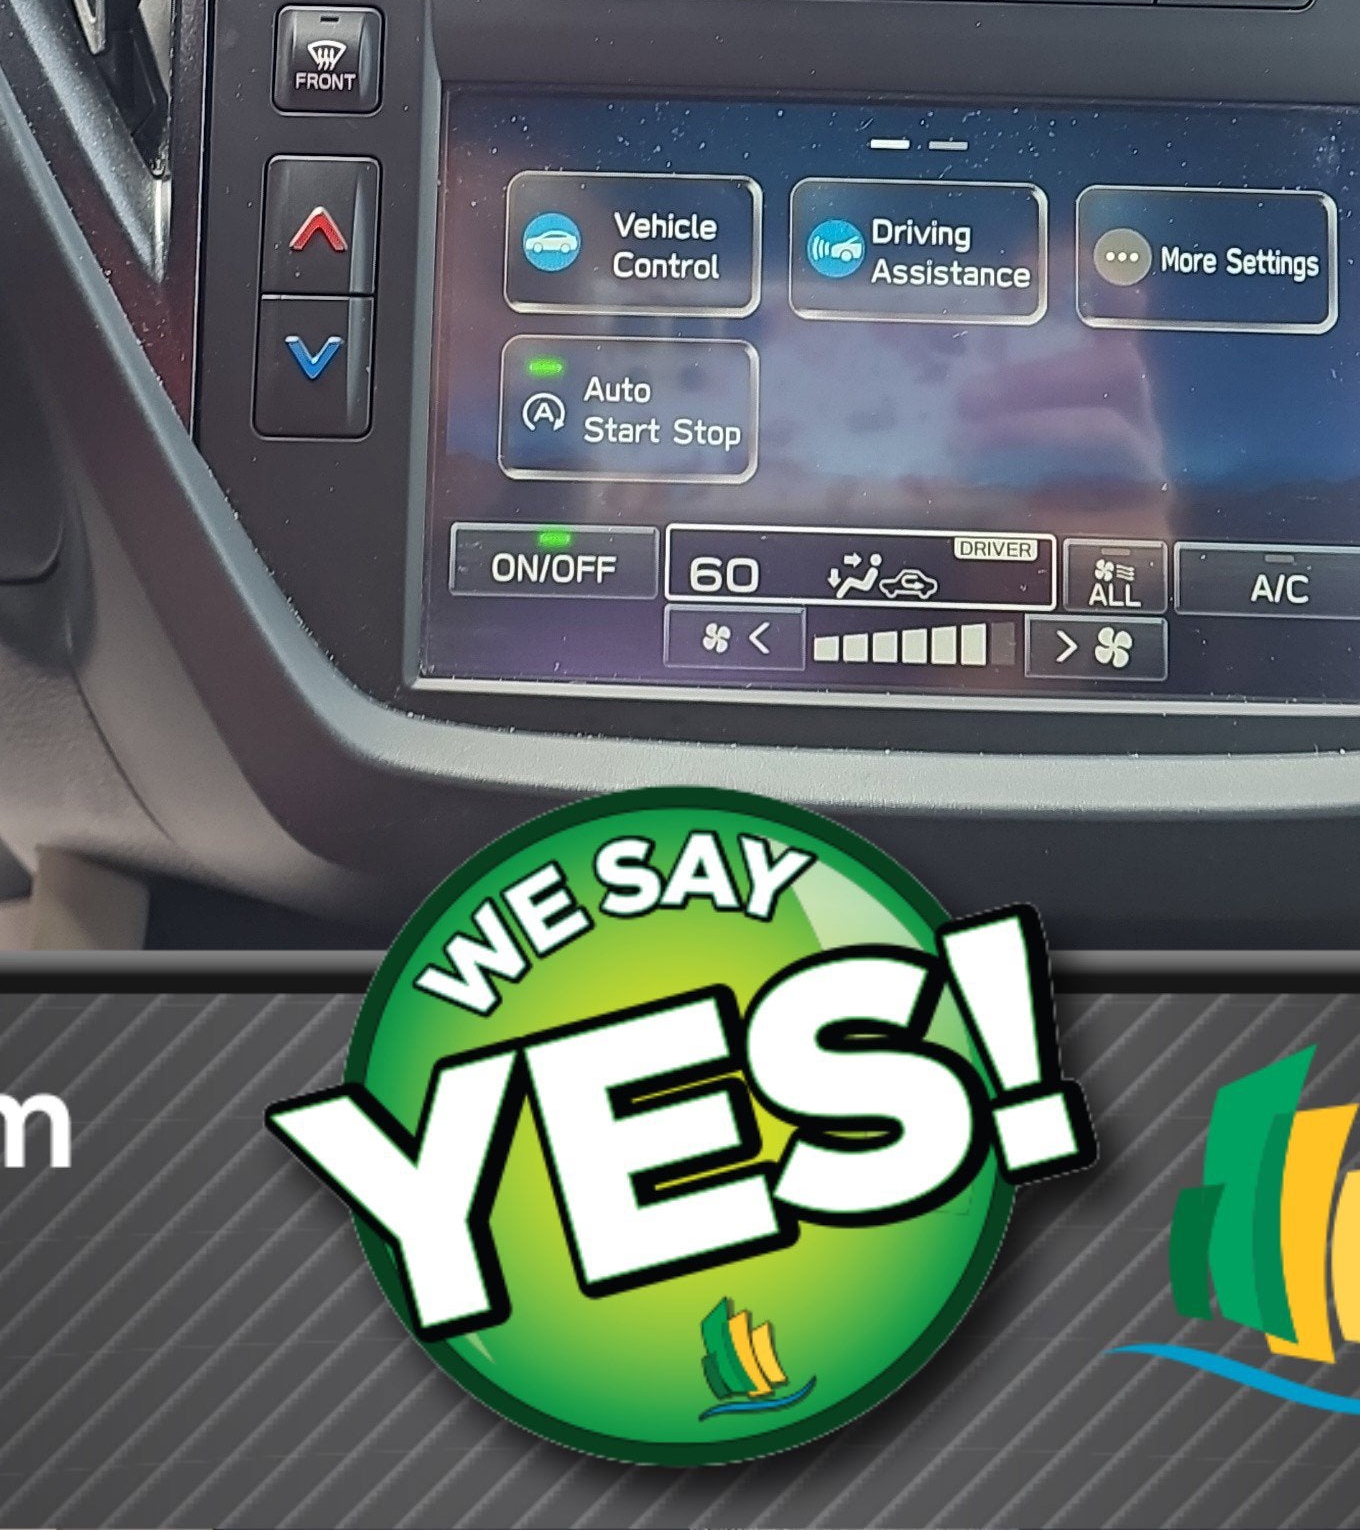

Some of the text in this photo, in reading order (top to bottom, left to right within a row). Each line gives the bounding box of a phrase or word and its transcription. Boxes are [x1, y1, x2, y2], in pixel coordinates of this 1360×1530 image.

[295, 72, 357, 91] FRONT
[613, 211, 718, 240] Vehicle
[872, 218, 971, 253] Driving
[613, 251, 720, 280] Control
[871, 258, 1031, 288] Assistance
[1161, 246, 1320, 283] More Settings
[583, 376, 651, 403] Auto
[583, 416, 741, 452] Start Stop
[960, 540, 1032, 557] DRIVER
[491, 552, 617, 584] ON/OFF
[690, 556, 759, 593] 60
[1088, 582, 1142, 608] ALL
[1250, 574, 1309, 604] A/C
